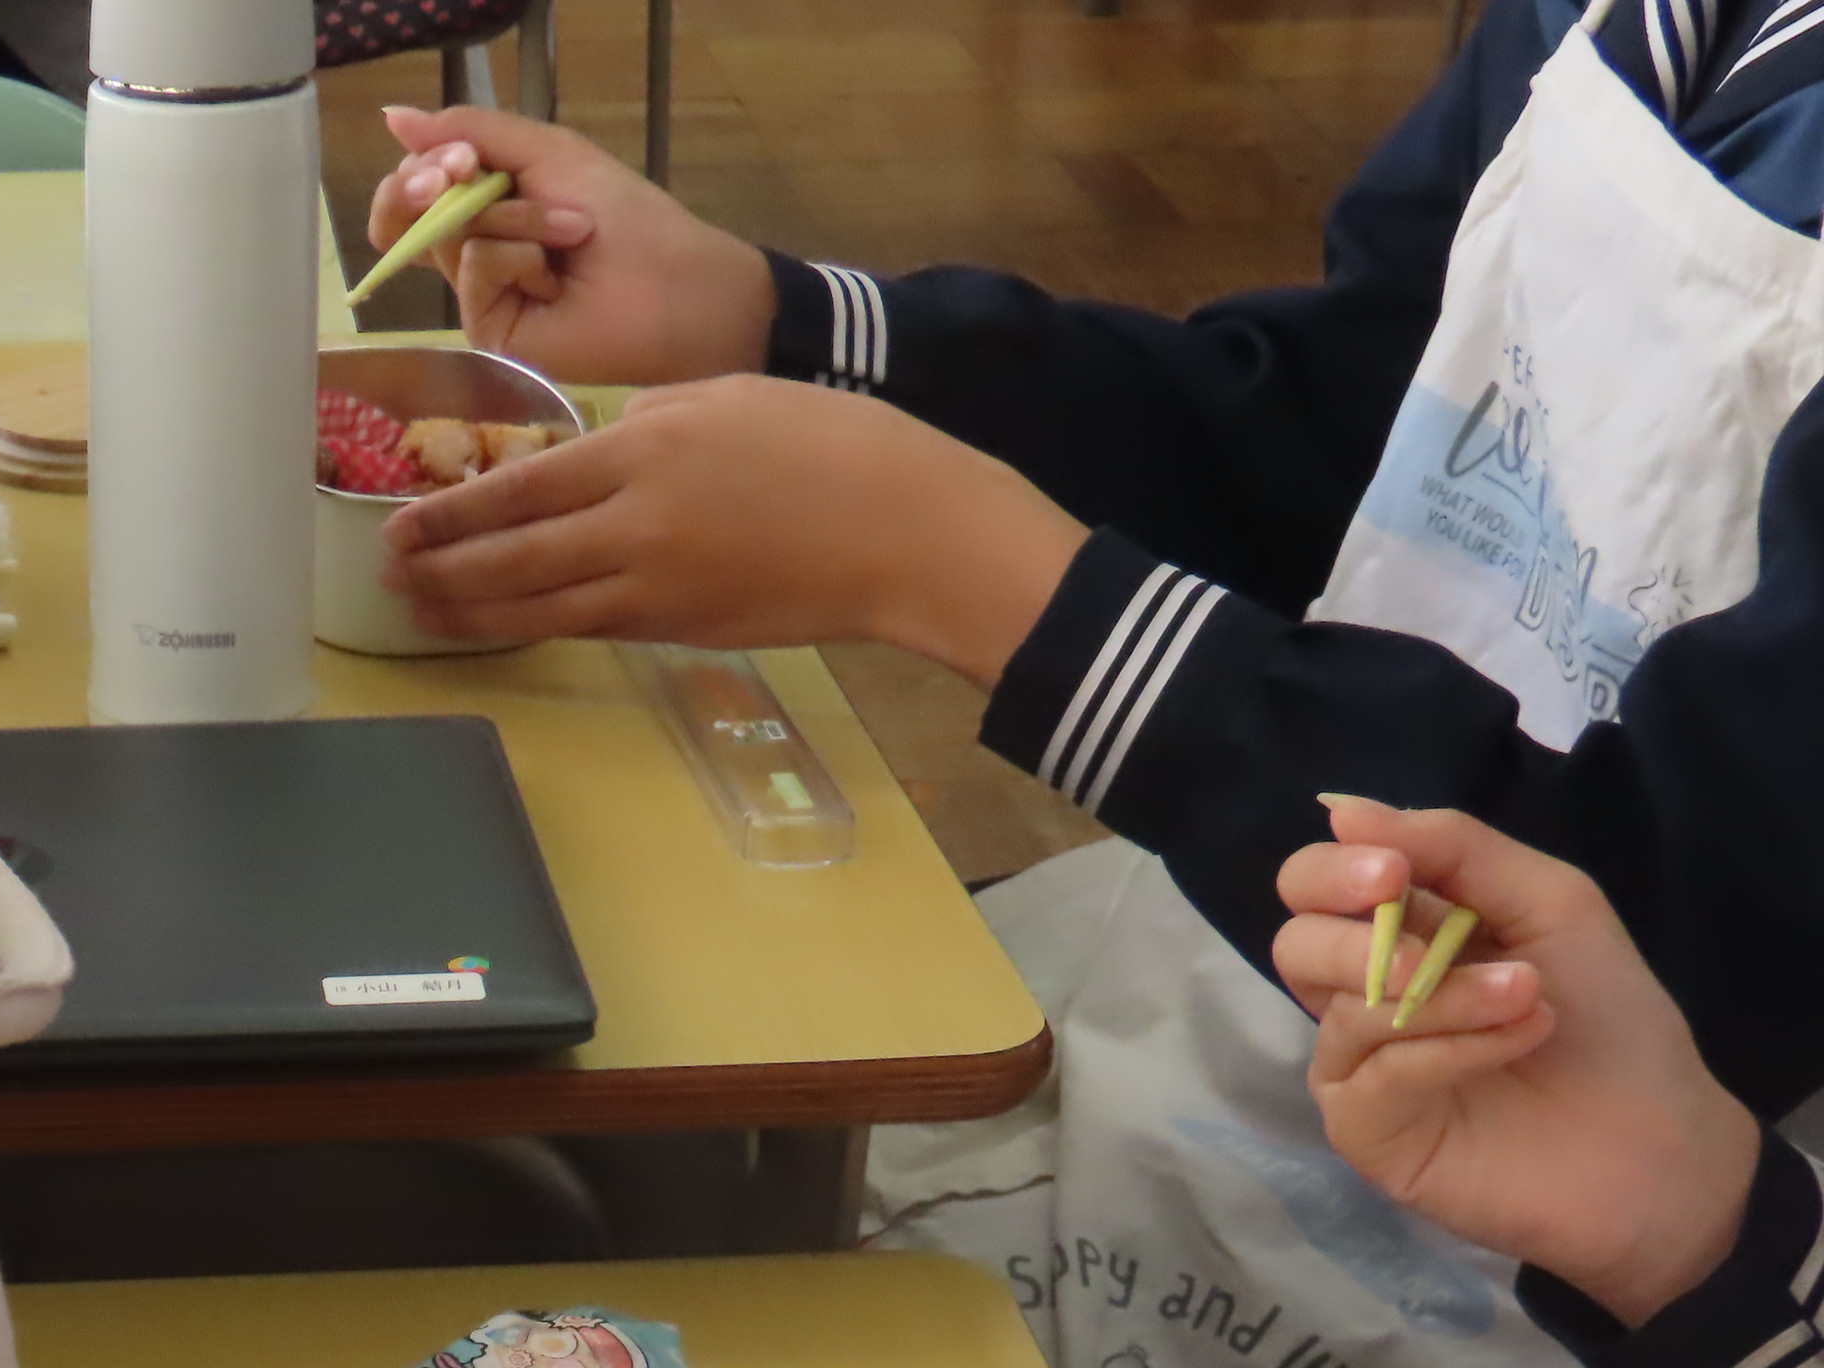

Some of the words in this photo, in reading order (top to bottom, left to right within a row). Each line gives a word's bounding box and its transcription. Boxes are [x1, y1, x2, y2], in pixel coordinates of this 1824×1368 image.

[1419, 475, 1474, 514] WHAT
[1427, 509, 1461, 541] YOU
[1462, 529, 1502, 566] LIKE
[1158, 1272, 1283, 1356] and
